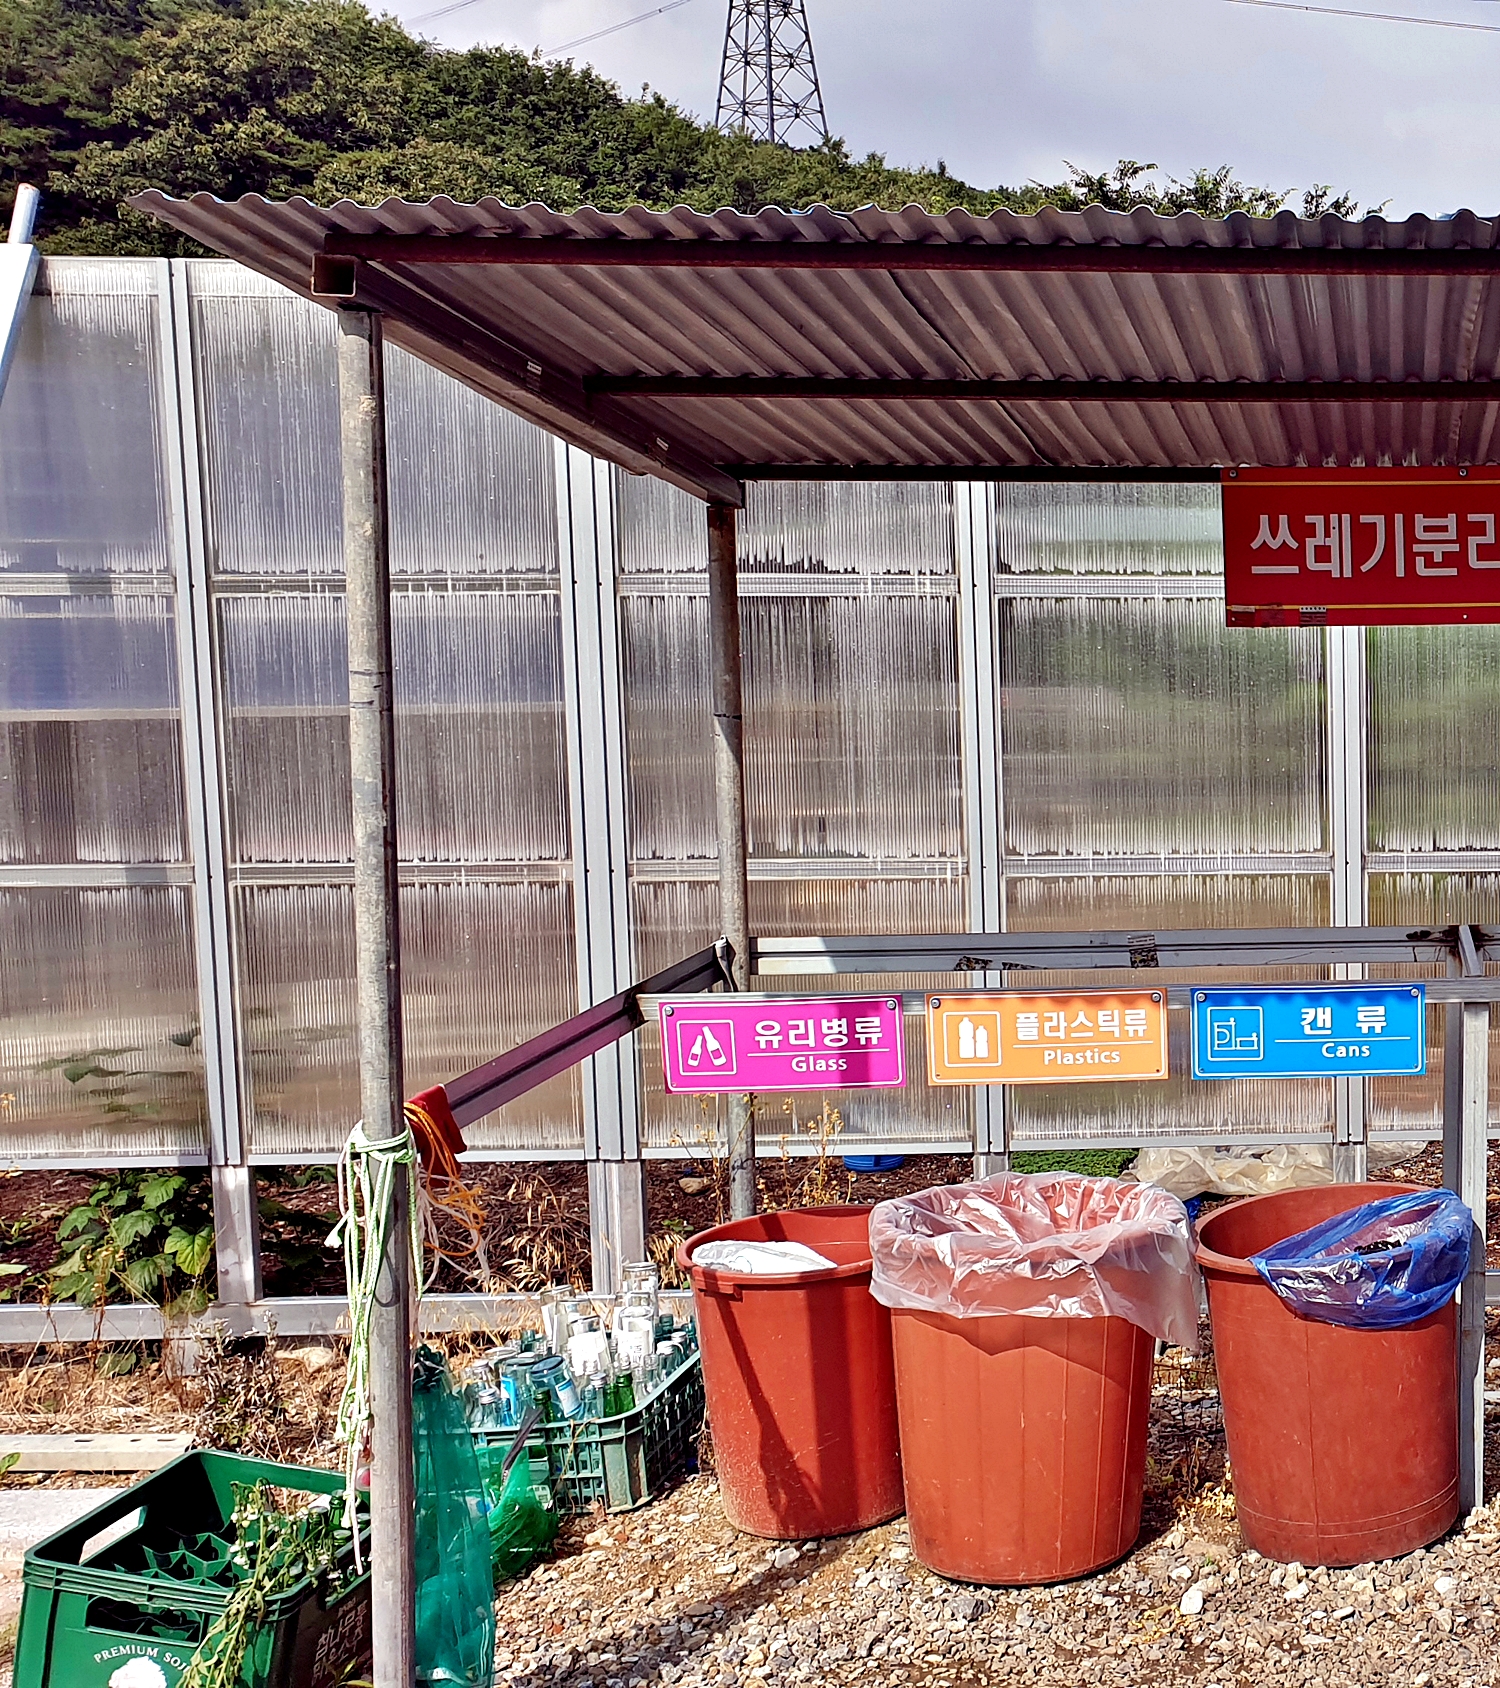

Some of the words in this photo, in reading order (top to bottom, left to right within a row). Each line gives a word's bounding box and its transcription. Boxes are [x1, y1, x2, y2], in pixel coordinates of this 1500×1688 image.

[1015, 1008, 1148, 1041] 플라스틱류
[1300, 1006, 1333, 1036] 캔
[1355, 1004, 1388, 1034] 류
[754, 1016, 883, 1050] 유리병류
[1043, 1047, 1121, 1066] Plastics
[1321, 1040, 1371, 1058] Cans
[790, 1054, 848, 1073] Glass
[93, 1644, 159, 1663] PREMIUM
